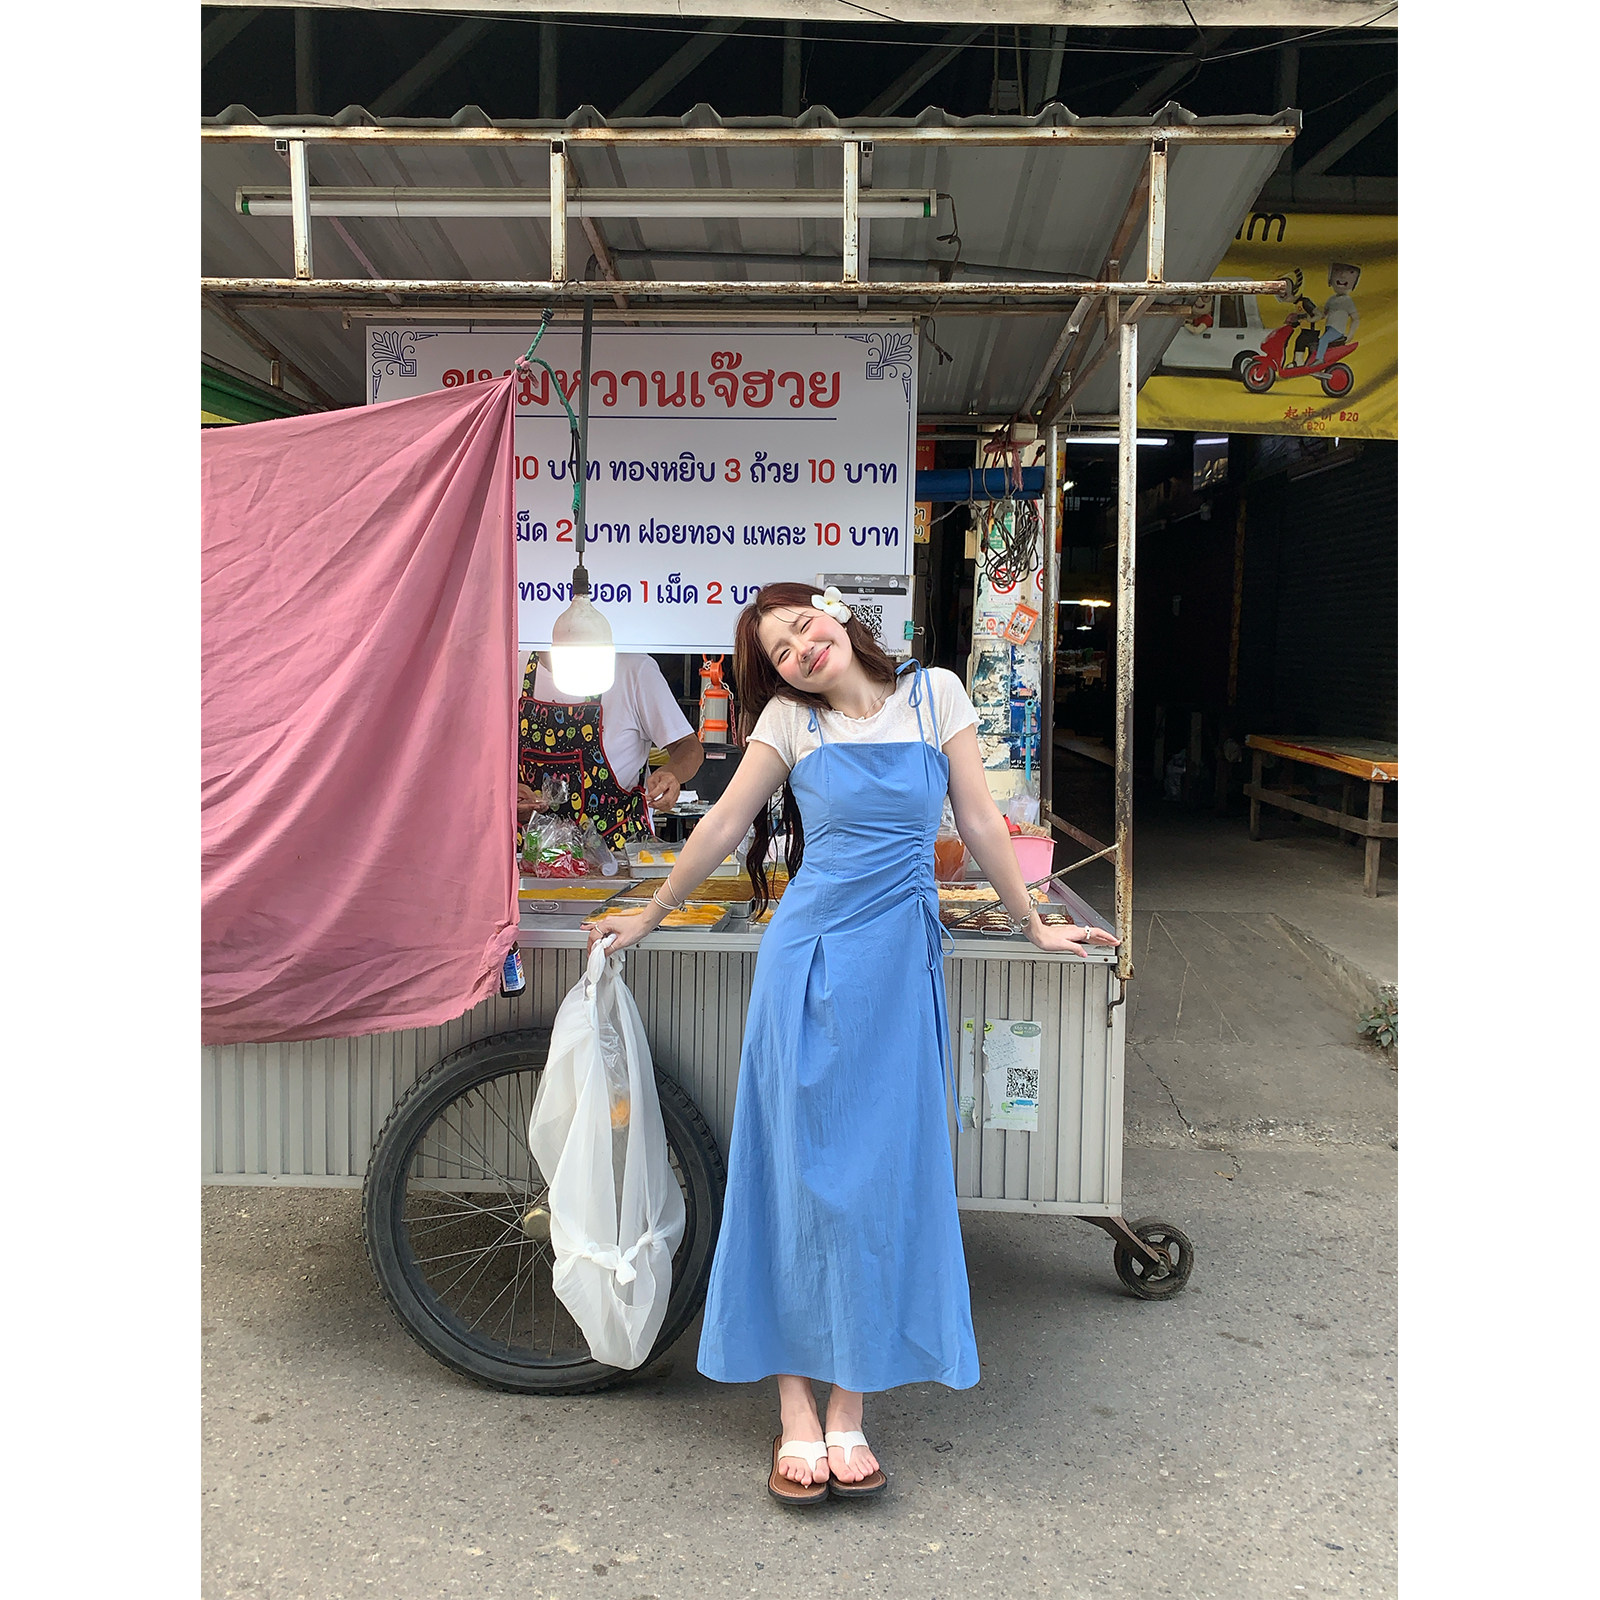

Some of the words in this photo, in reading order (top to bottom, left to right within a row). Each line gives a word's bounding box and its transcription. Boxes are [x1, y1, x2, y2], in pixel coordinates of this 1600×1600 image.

[442, 351, 841, 409] มหวานเจ๊ฮวย
[515, 455, 539, 480] 10
[609, 451, 716, 483] ทองหยิบ
[724, 458, 741, 483] 3
[750, 451, 799, 484] ถ้วย
[808, 458, 836, 484] 10
[844, 462, 897, 484] บาท
[556, 519, 573, 542] 2
[585, 523, 631, 544] บาท
[638, 518, 735, 545] ฝอยทอง
[743, 525, 806, 546] แพละ
[814, 522, 841, 546] 10
[849, 526, 899, 547] บาท
[640, 580, 649, 604] 1
[657, 572, 699, 605] เม็ด
[706, 581, 723, 605] 2
